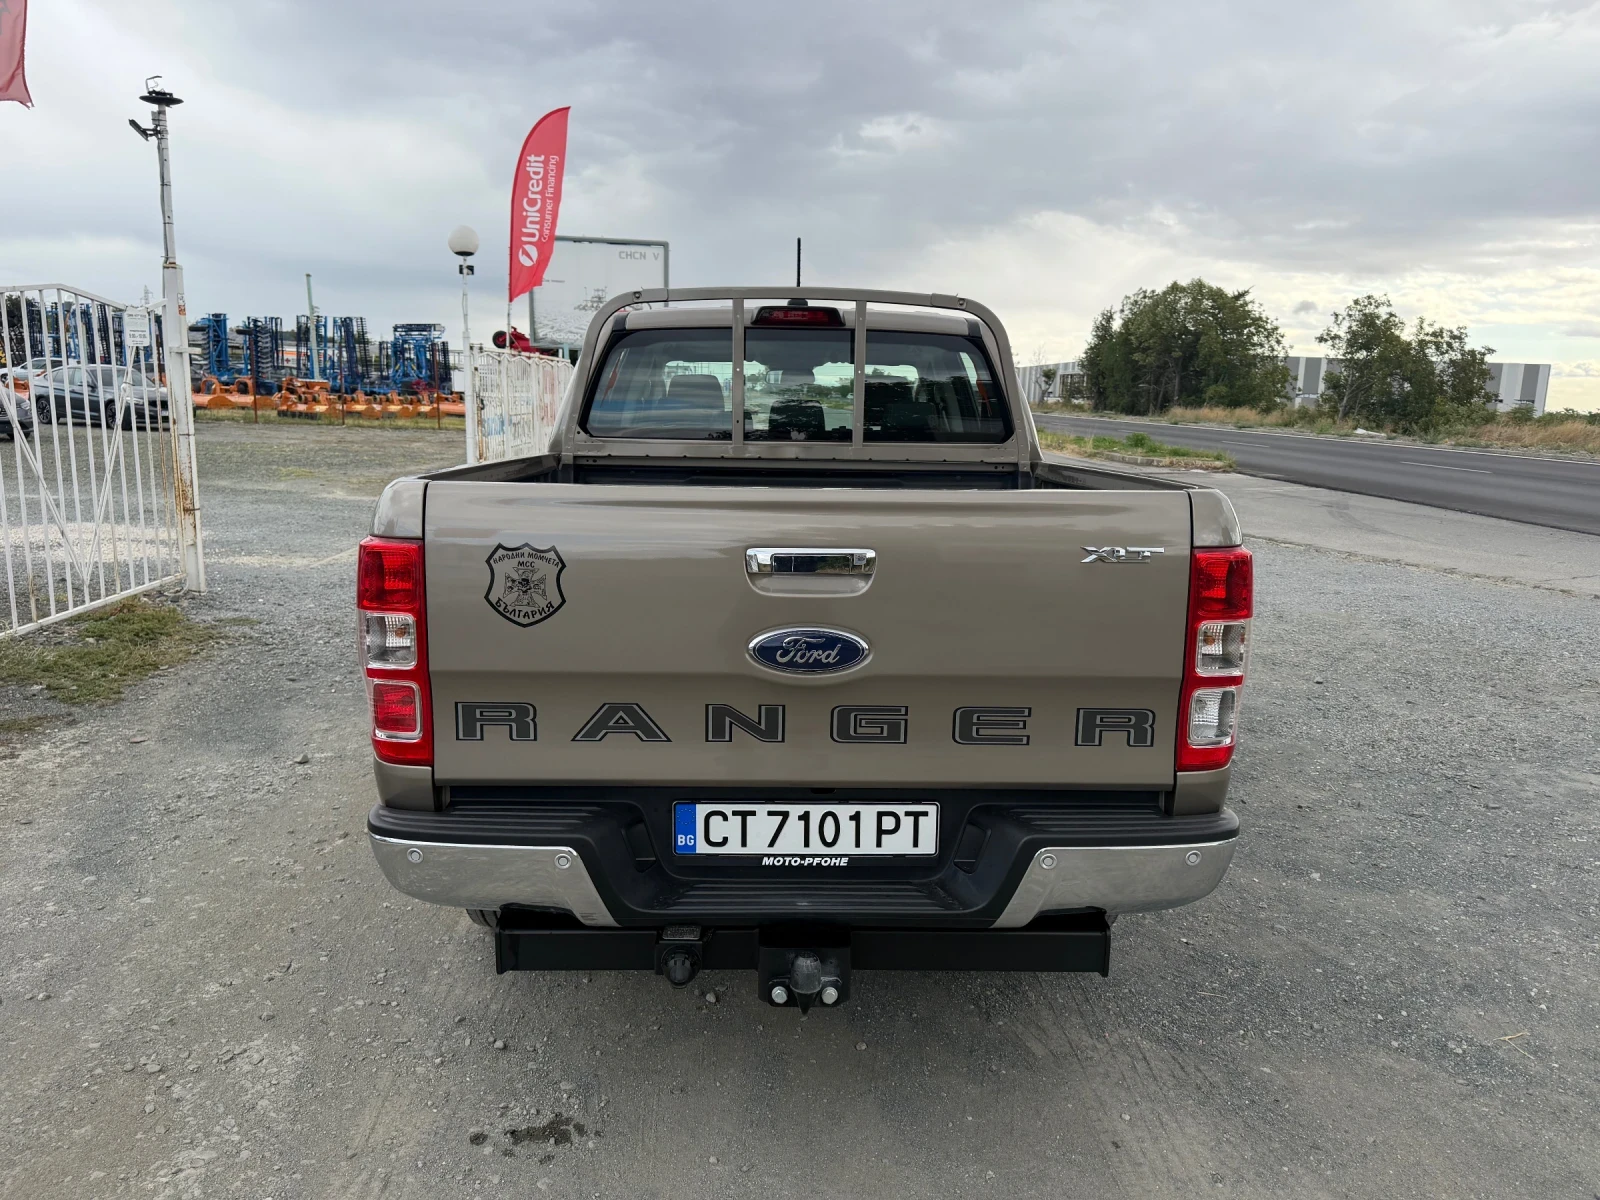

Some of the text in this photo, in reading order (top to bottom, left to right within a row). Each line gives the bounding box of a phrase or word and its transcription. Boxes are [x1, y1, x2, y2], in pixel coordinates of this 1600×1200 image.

[521, 154, 545, 242] UniCredit
[541, 155, 559, 243] Consumer Financing
[493, 552, 525, 564] НАРОДНИ
[495, 597, 555, 619] БЪЛГАРИЯ
[775, 636, 842, 664] Ford
[455, 701, 1156, 747] RANGER
[677, 834, 695, 846] BG
[761, 856, 849, 867] MOTO-PFOHE
